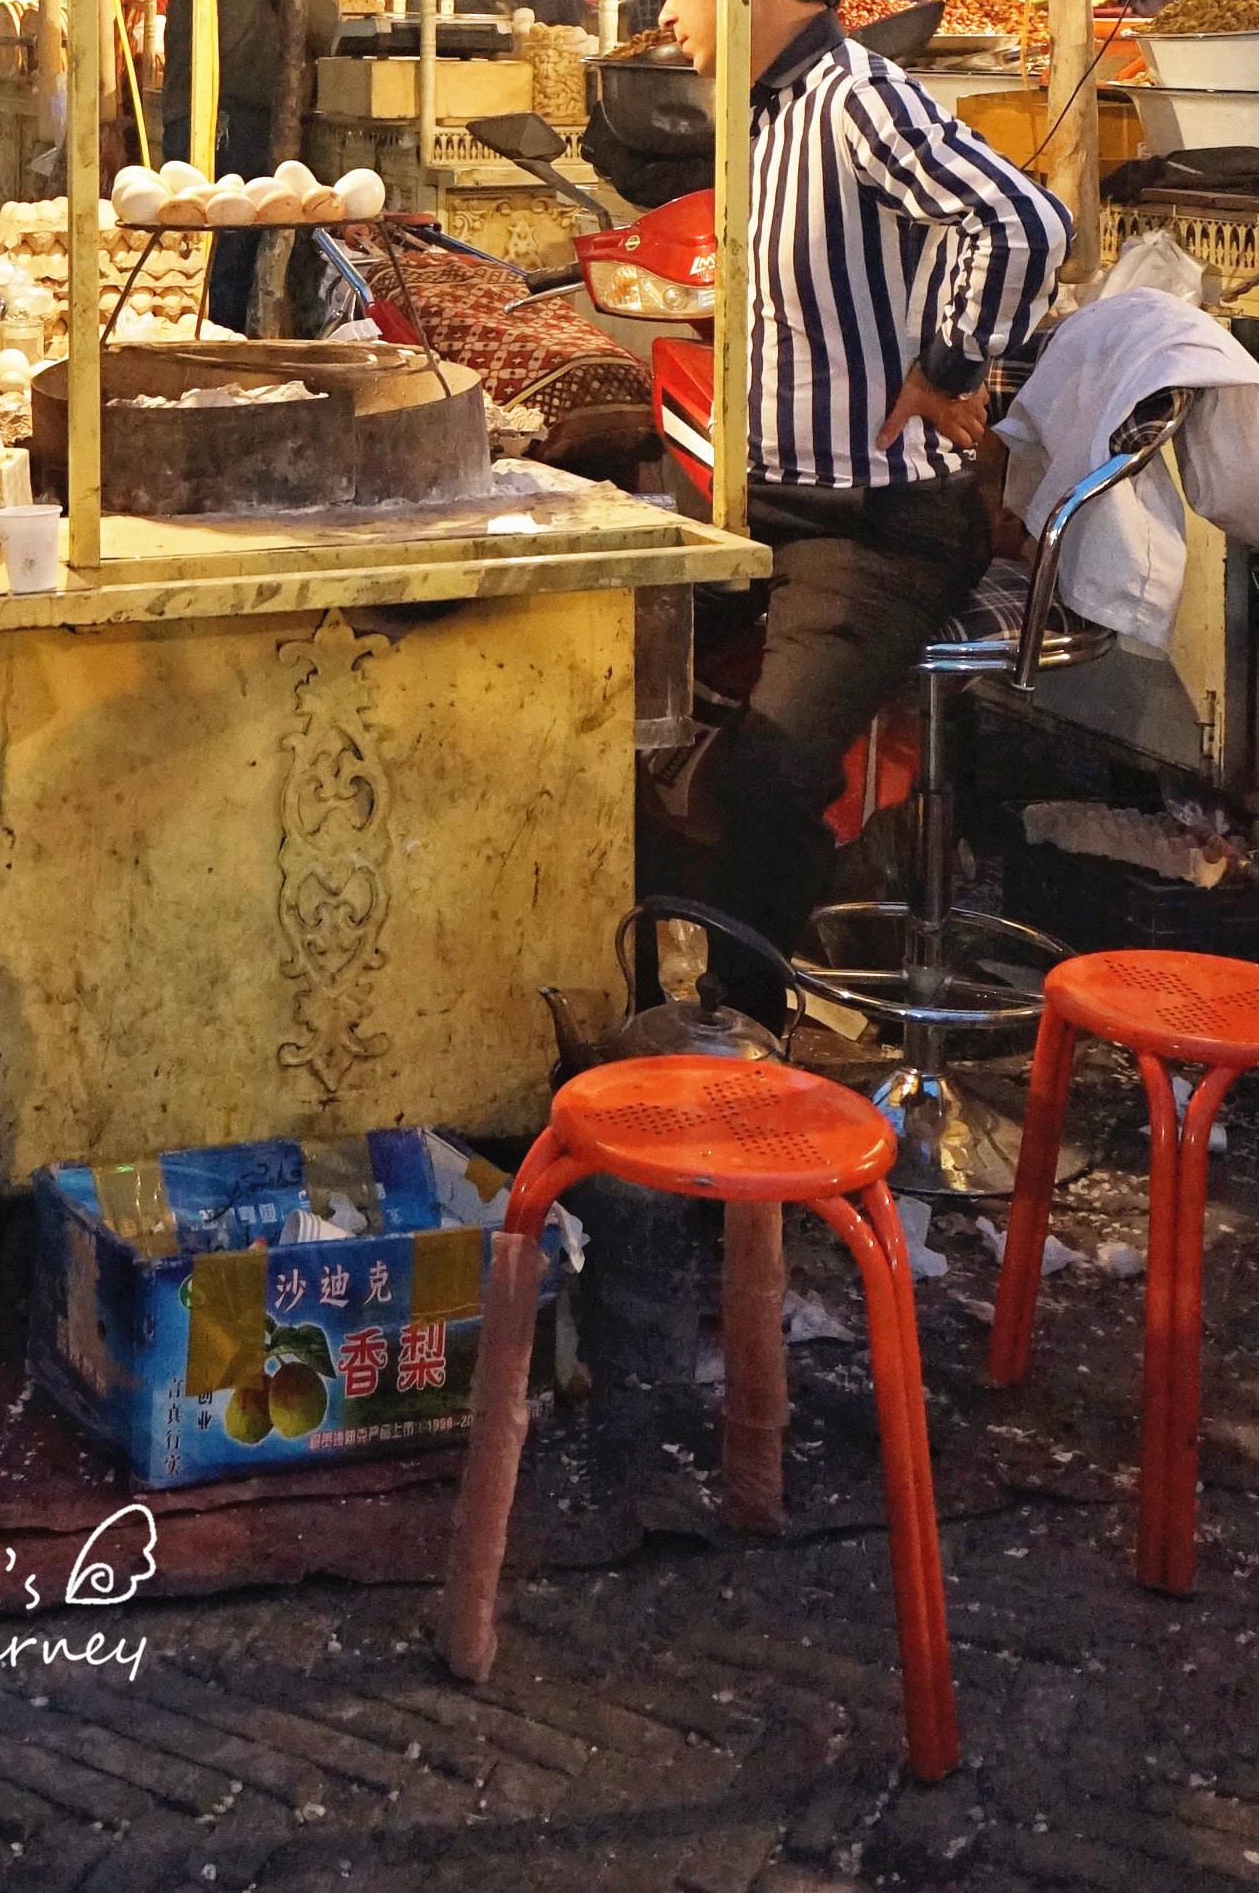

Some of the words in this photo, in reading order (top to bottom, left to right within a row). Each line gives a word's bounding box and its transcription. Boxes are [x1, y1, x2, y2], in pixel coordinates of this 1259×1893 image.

[275, 1259, 393, 1314] 沙迪克
[338, 1319, 447, 1400] 香梨
